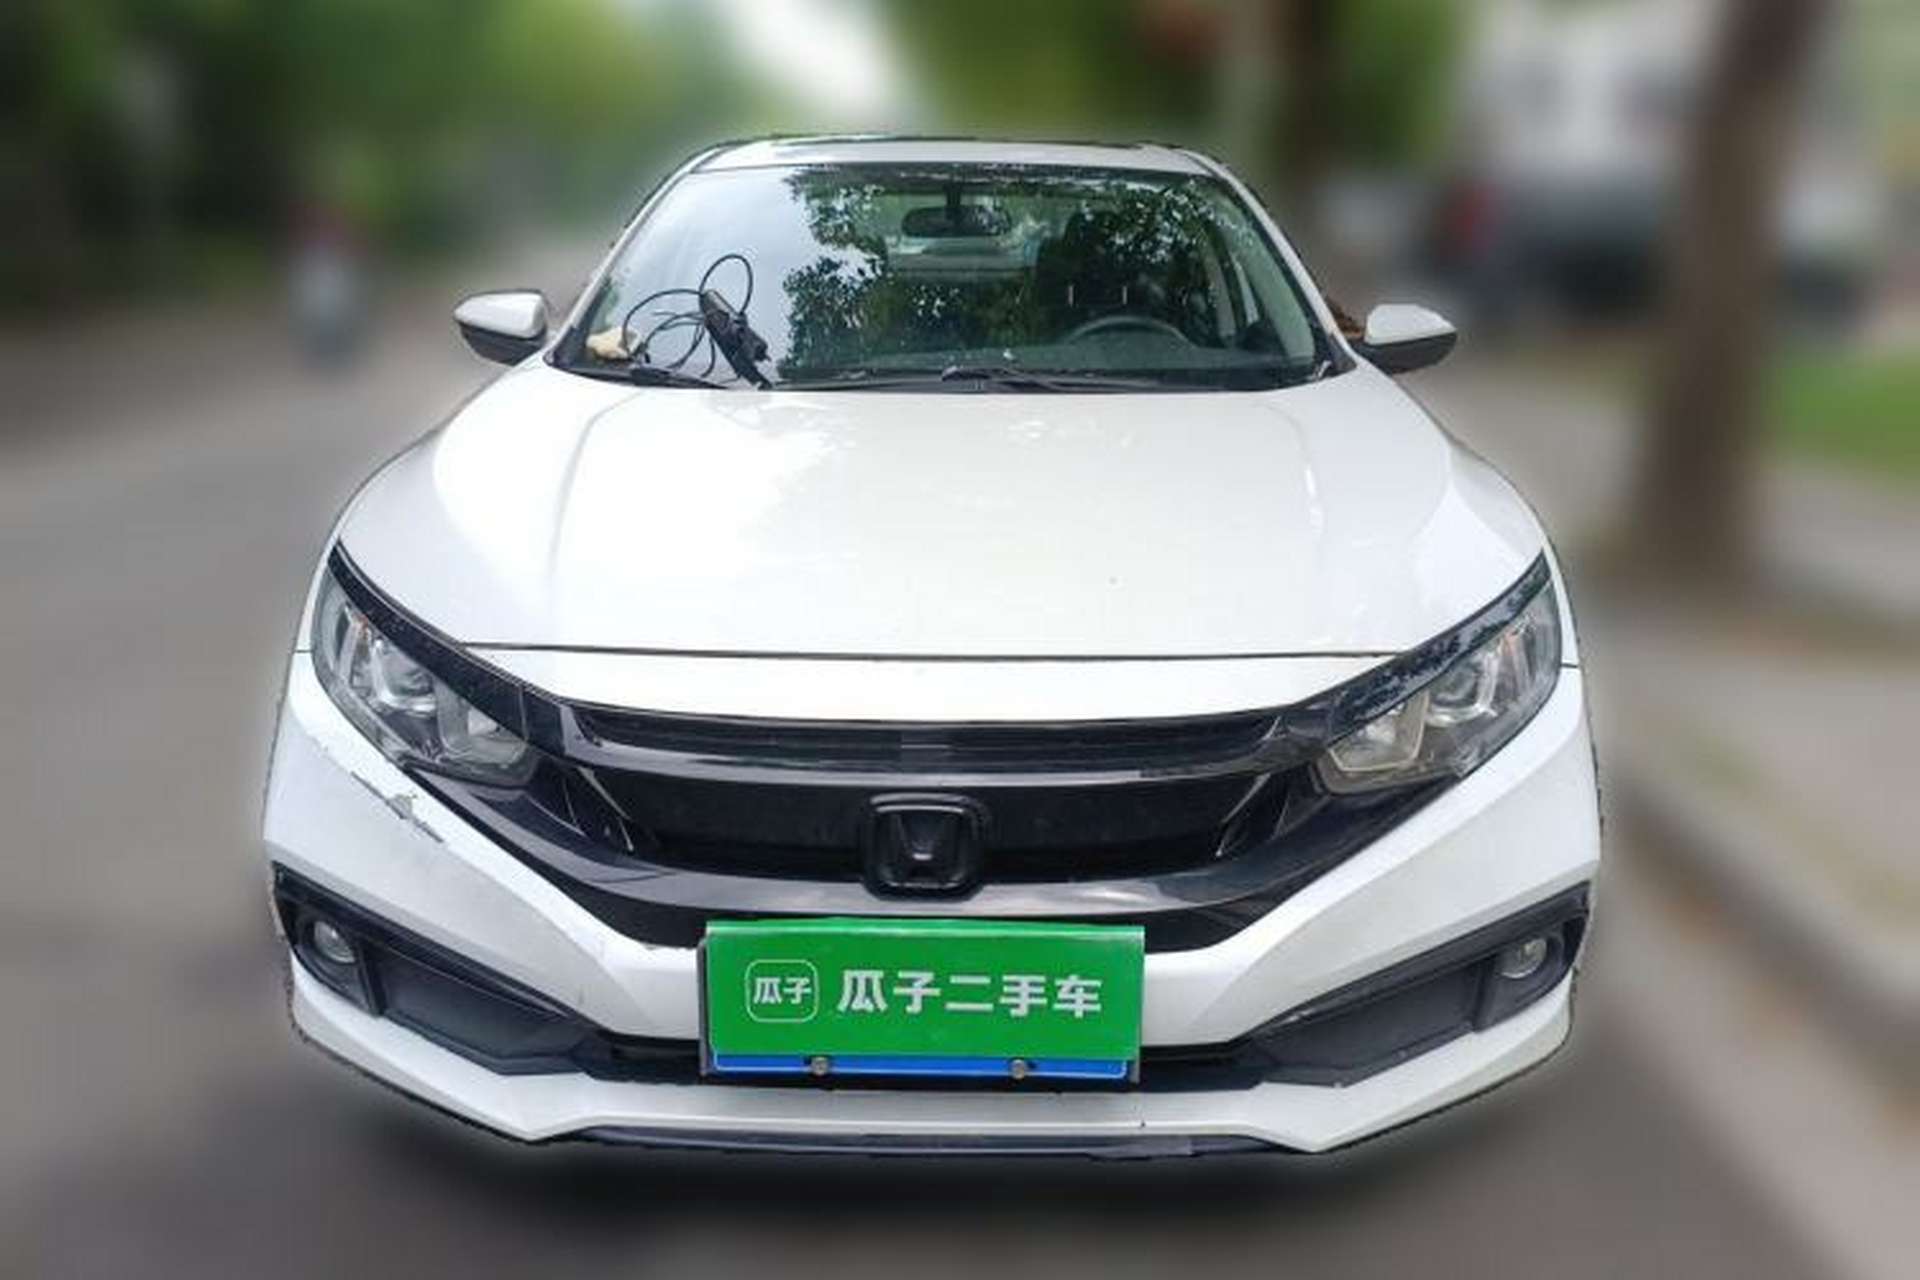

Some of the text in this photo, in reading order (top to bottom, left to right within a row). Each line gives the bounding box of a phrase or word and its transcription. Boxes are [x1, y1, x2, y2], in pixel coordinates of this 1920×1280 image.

[753, 977, 812, 1005] 瓜子
[837, 969, 1102, 1018] 瓜子二手车
